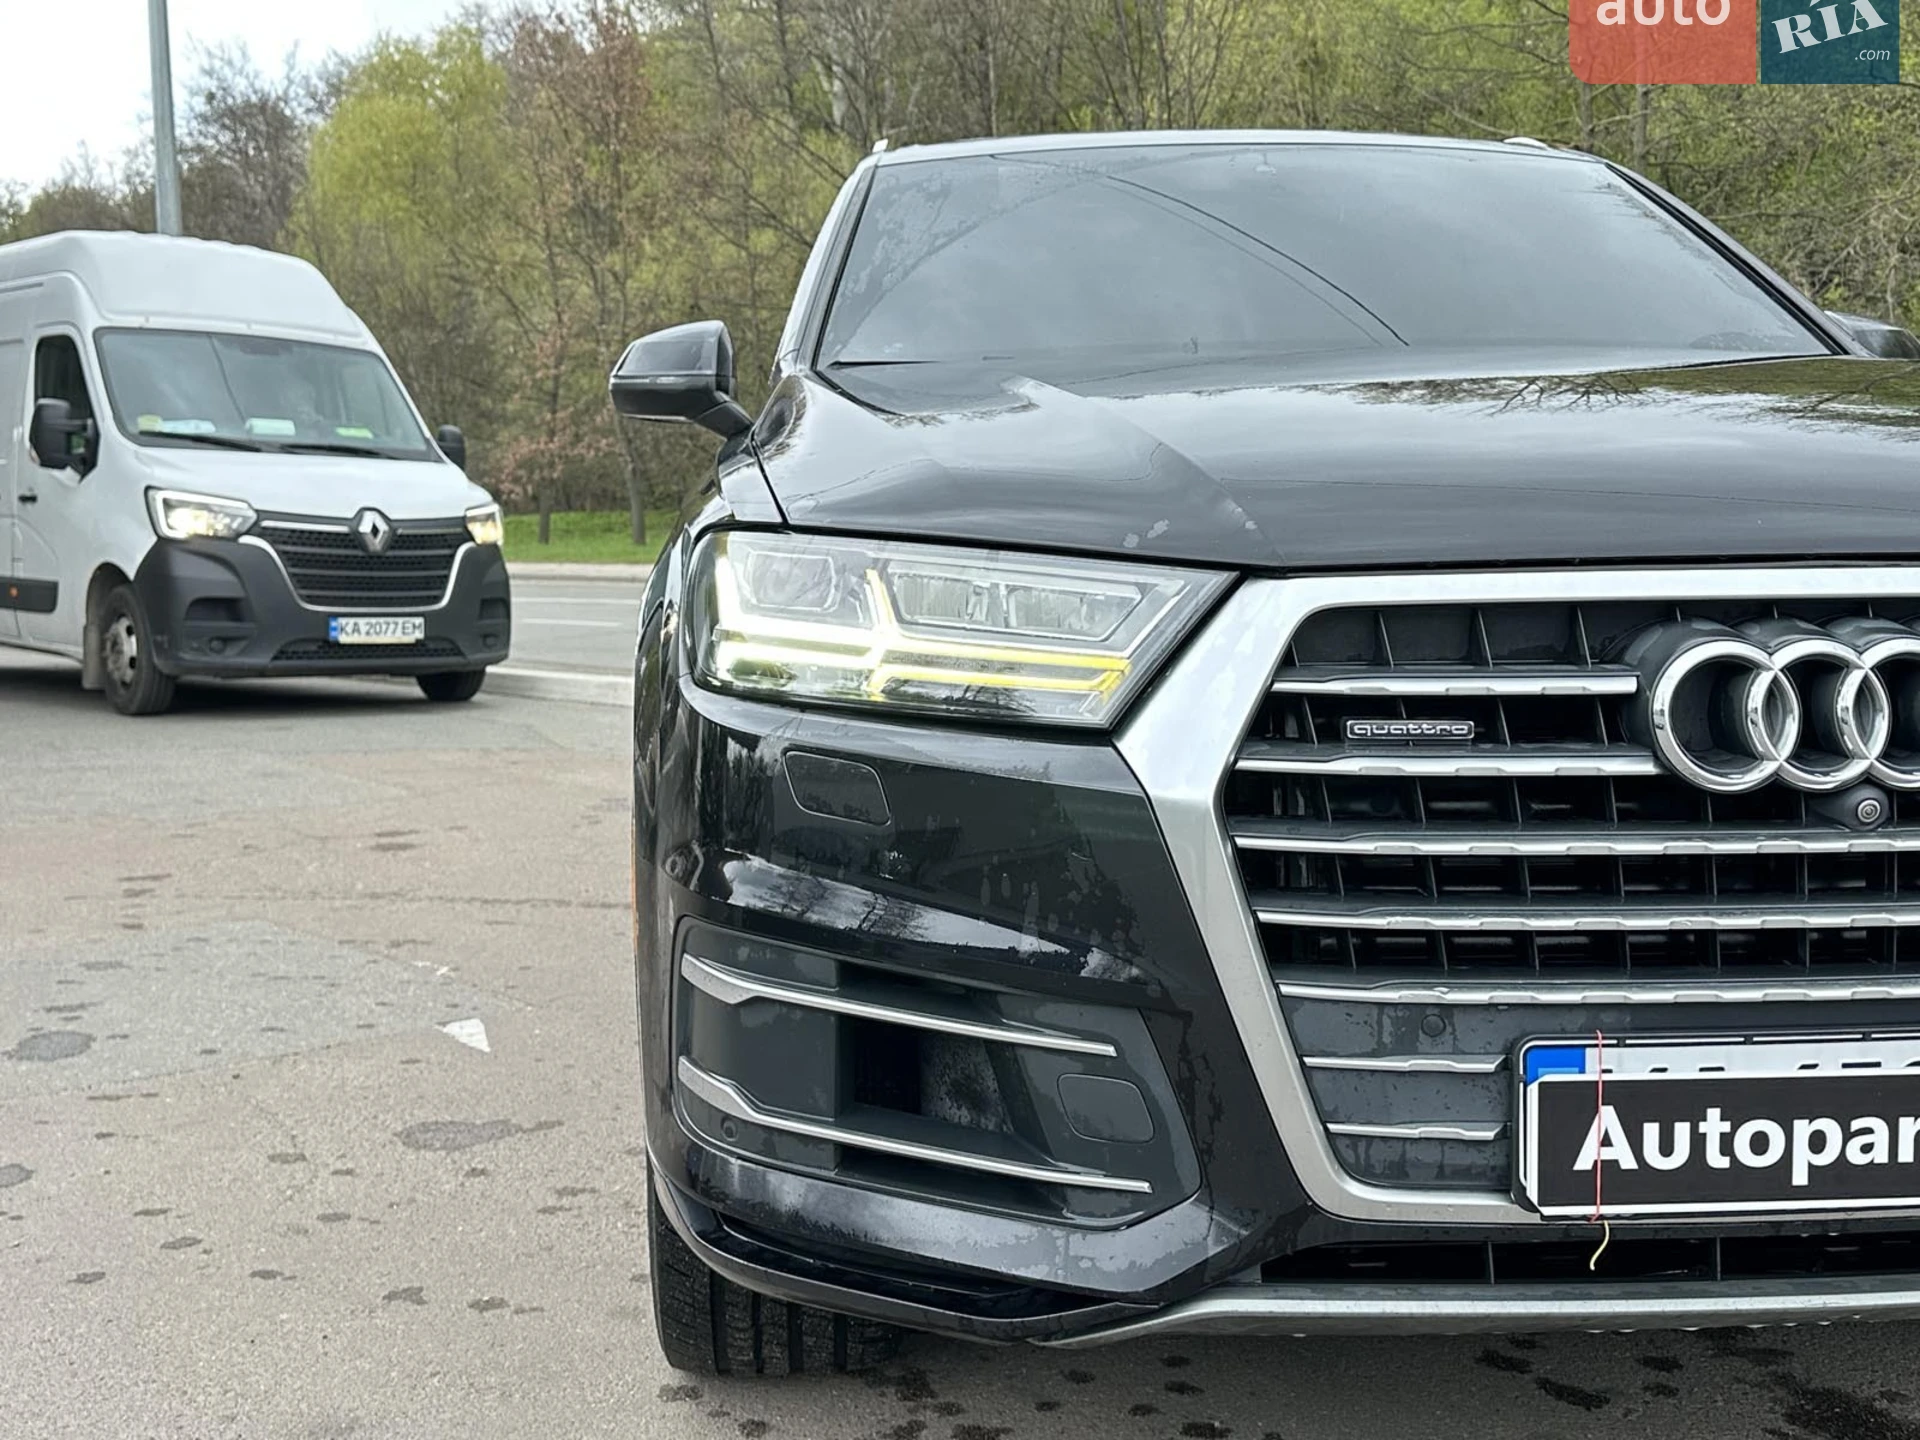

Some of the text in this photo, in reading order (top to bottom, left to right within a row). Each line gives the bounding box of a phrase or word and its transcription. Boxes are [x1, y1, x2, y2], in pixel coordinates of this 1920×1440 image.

[364, 621, 399, 636] 2077
[1353, 723, 1469, 736] quattro
[1572, 1105, 1920, 1186] Autopar
